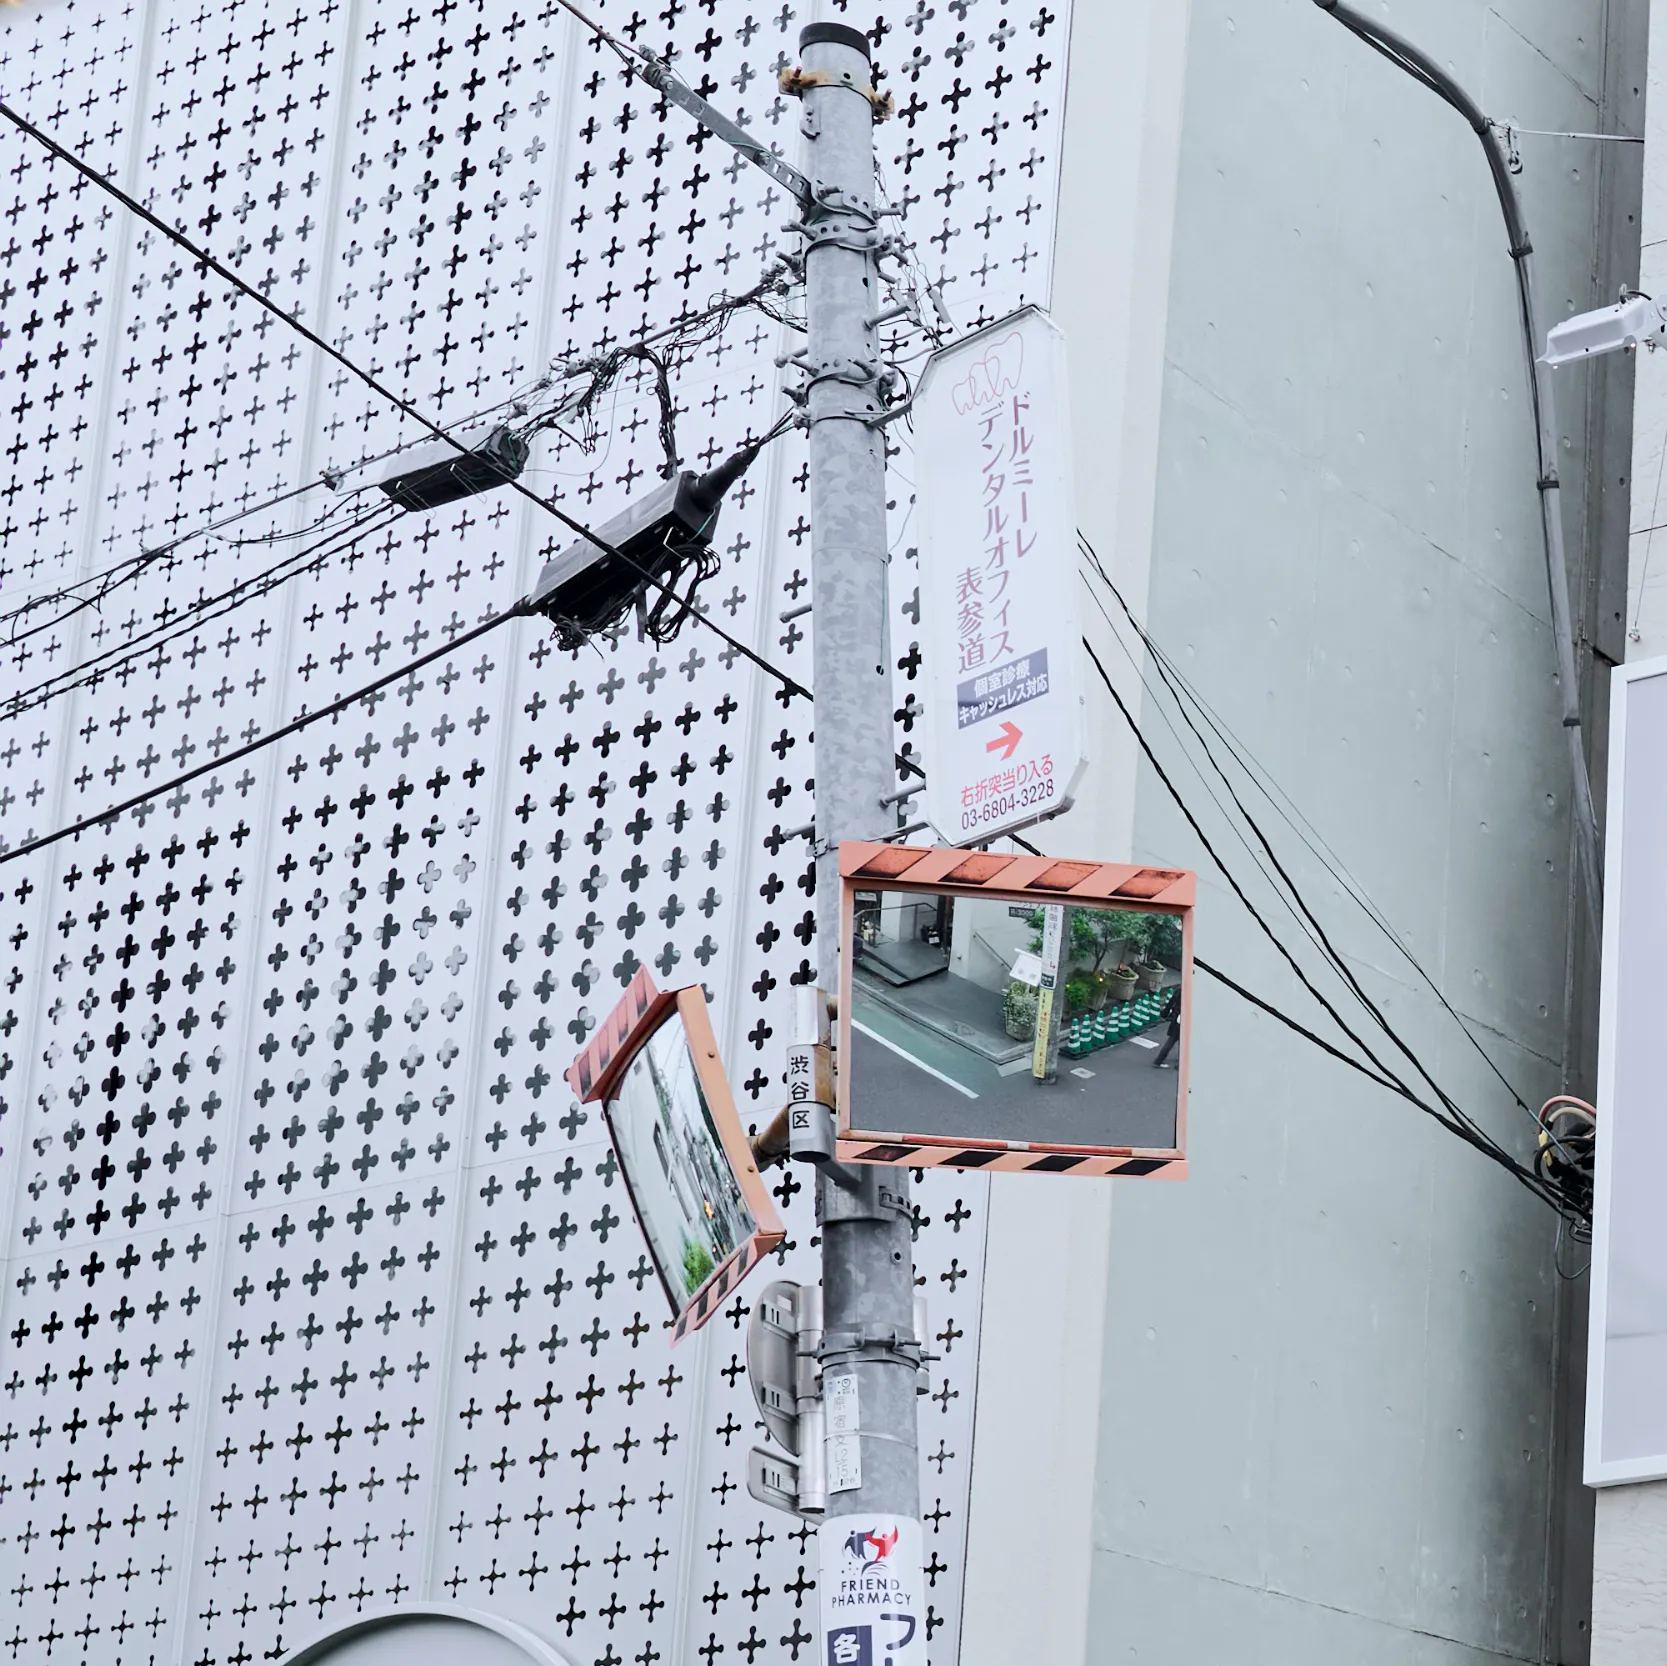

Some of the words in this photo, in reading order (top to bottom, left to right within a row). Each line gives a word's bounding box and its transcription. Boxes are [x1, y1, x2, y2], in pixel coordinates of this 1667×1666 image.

[1009, 391, 1038, 558] ドルミーレ
[978, 401, 1014, 664] デンタルオフィス
[956, 566, 986, 674] 表参道
[959, 673, 1048, 724] キャッシュレス対応
[974, 659, 1031, 698] 個室診療
[961, 754, 1053, 807] 右折突当り入る
[961, 778, 1054, 830] 03-6804-3228
[790, 1055, 810, 1129] 渋谷区
[832, 1592, 911, 1608] PHARMACY
[841, 1578, 900, 1593] FRIEND
